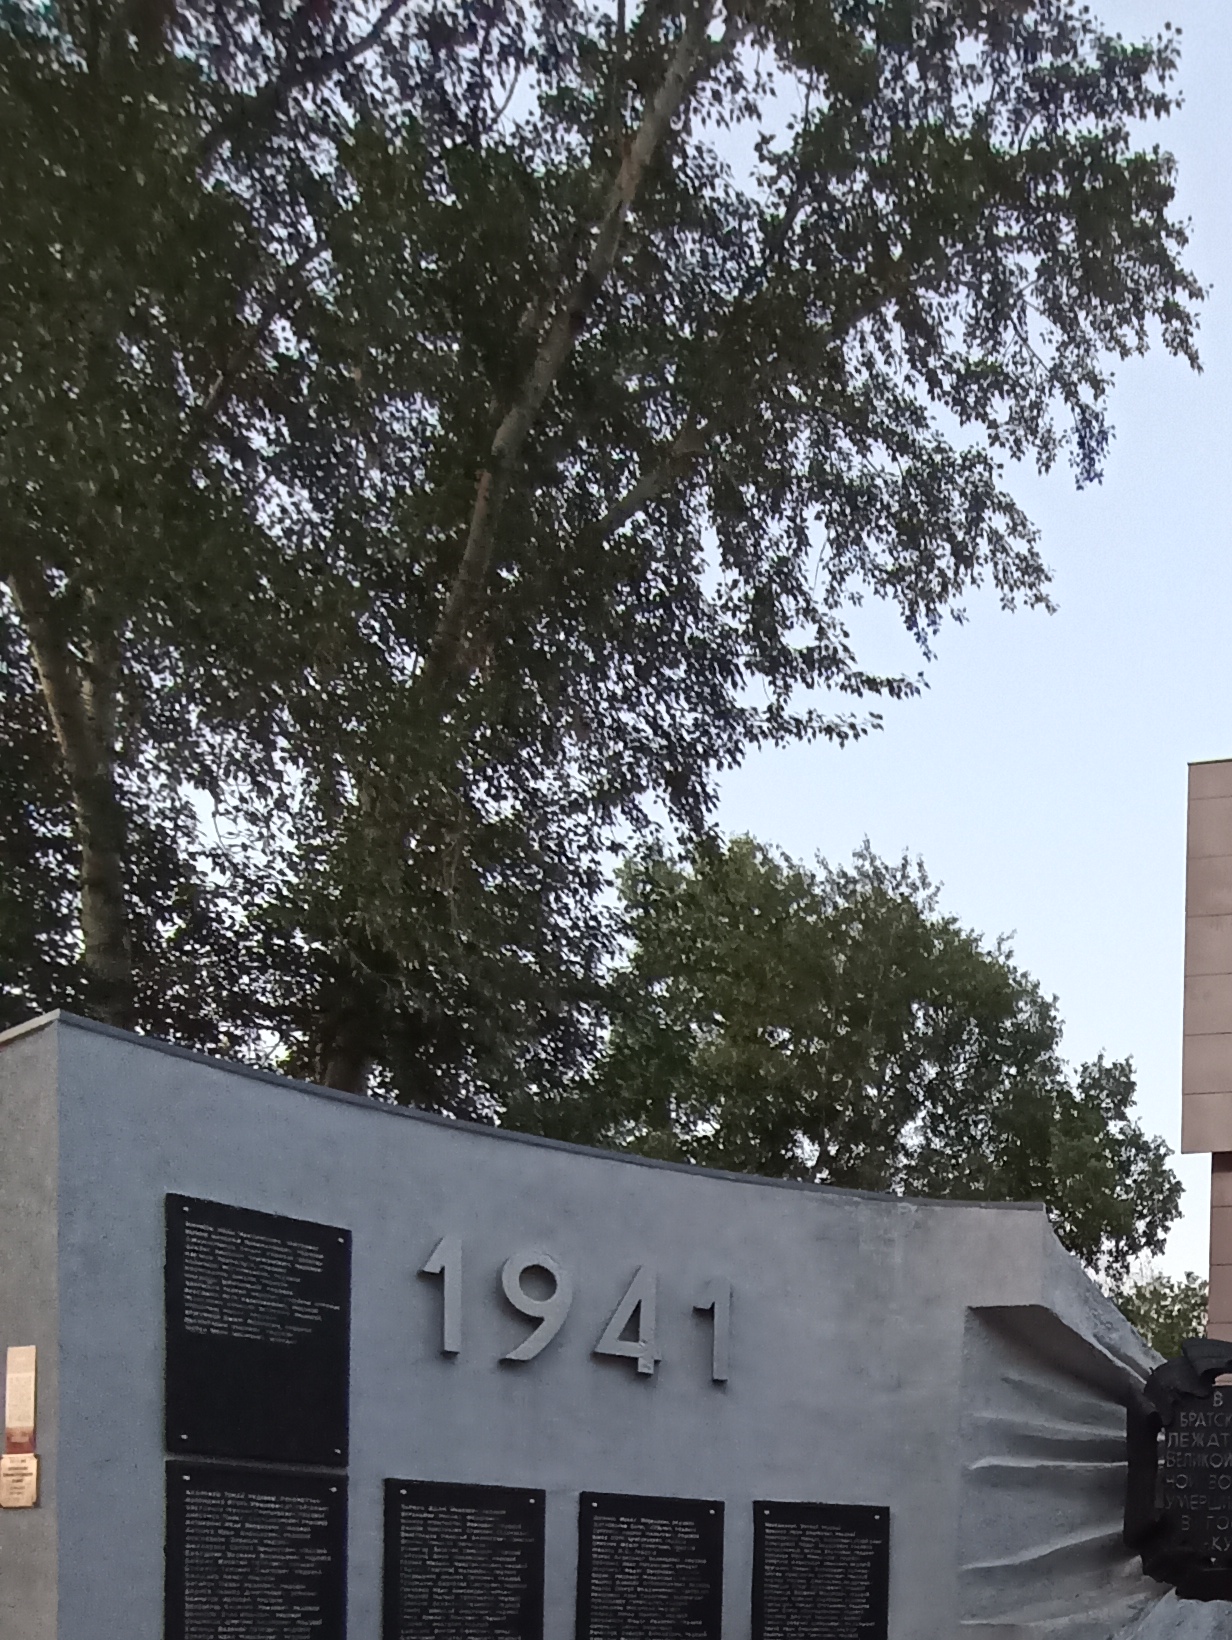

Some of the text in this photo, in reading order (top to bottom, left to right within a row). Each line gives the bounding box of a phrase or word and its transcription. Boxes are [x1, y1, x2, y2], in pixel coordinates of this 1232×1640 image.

[417, 1235, 734, 1383] 1941
[1213, 1391, 1223, 1407] В
[1167, 1433, 1230, 1448] ЛЕЖАТ
